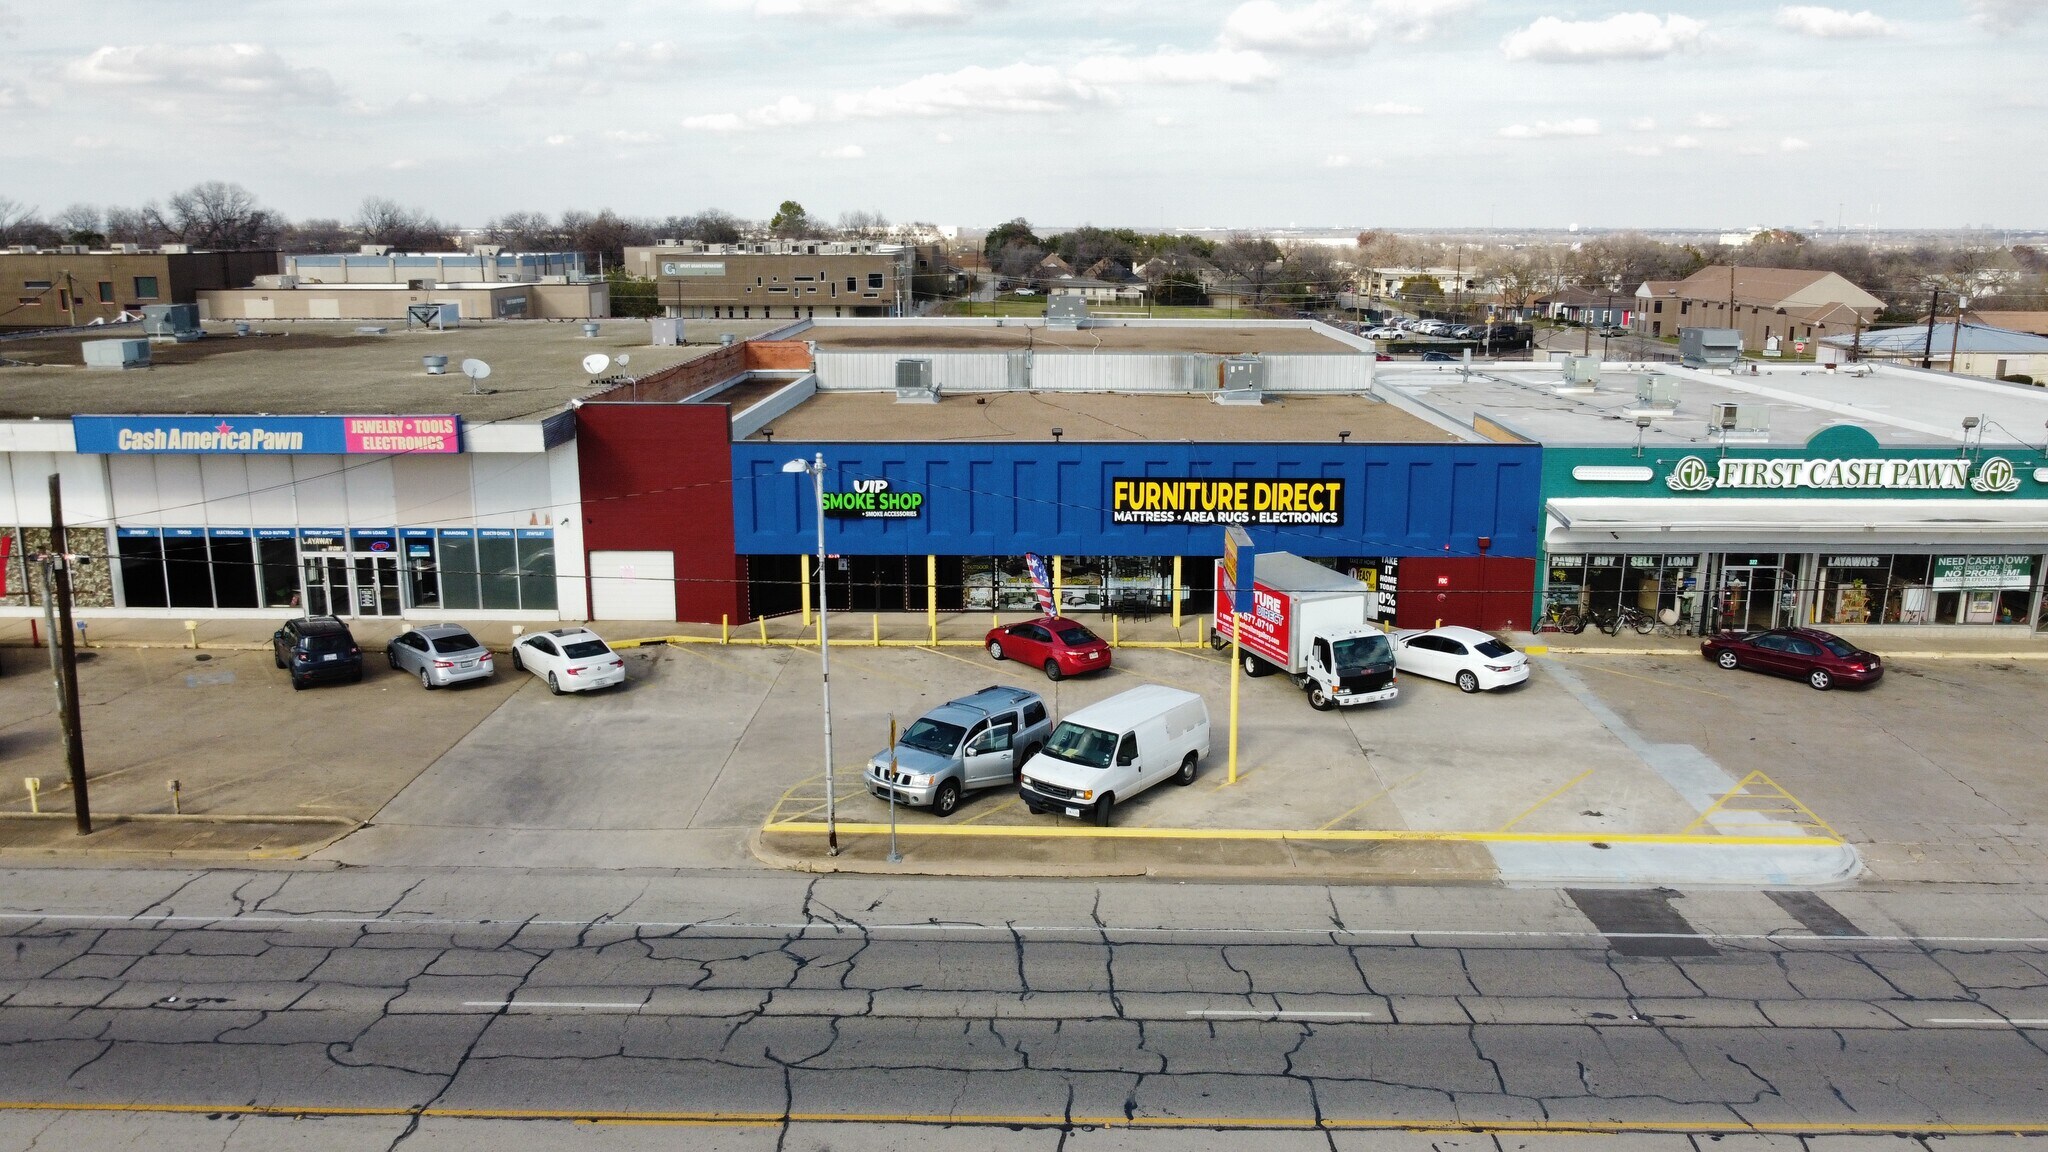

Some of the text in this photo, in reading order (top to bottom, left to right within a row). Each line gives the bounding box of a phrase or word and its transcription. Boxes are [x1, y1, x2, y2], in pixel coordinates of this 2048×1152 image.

[351, 420, 453, 434] JEWELRY TOOLS
[363, 436, 445, 450] ELECTRONICS
[1721, 462, 1970, 489] FIRST CASH PAWN
[853, 480, 888, 493] VIP
[822, 493, 922, 510] SMOKE SHOP
[1114, 481, 1341, 511] FURNITURE DIRECT
[1114, 511, 1338, 523] MATTRESS AREA RUGS ELECTRONICS
[1552, 556, 1582, 567] PAWN
[1594, 556, 1616, 566] BUY
[1630, 556, 1654, 567] SELL
[1667, 556, 1694, 567] LOAN
[1827, 556, 1879, 567] LAYAWAYS
[1938, 556, 2029, 566] NEED CASH NOW?
[1384, 565, 1393, 575] IT
[1380, 574, 1397, 585] HOME
[1378, 592, 1396, 607] 0%
[1378, 605, 1396, 615] DOWN
[1256, 605, 1284, 627] DIRECT
